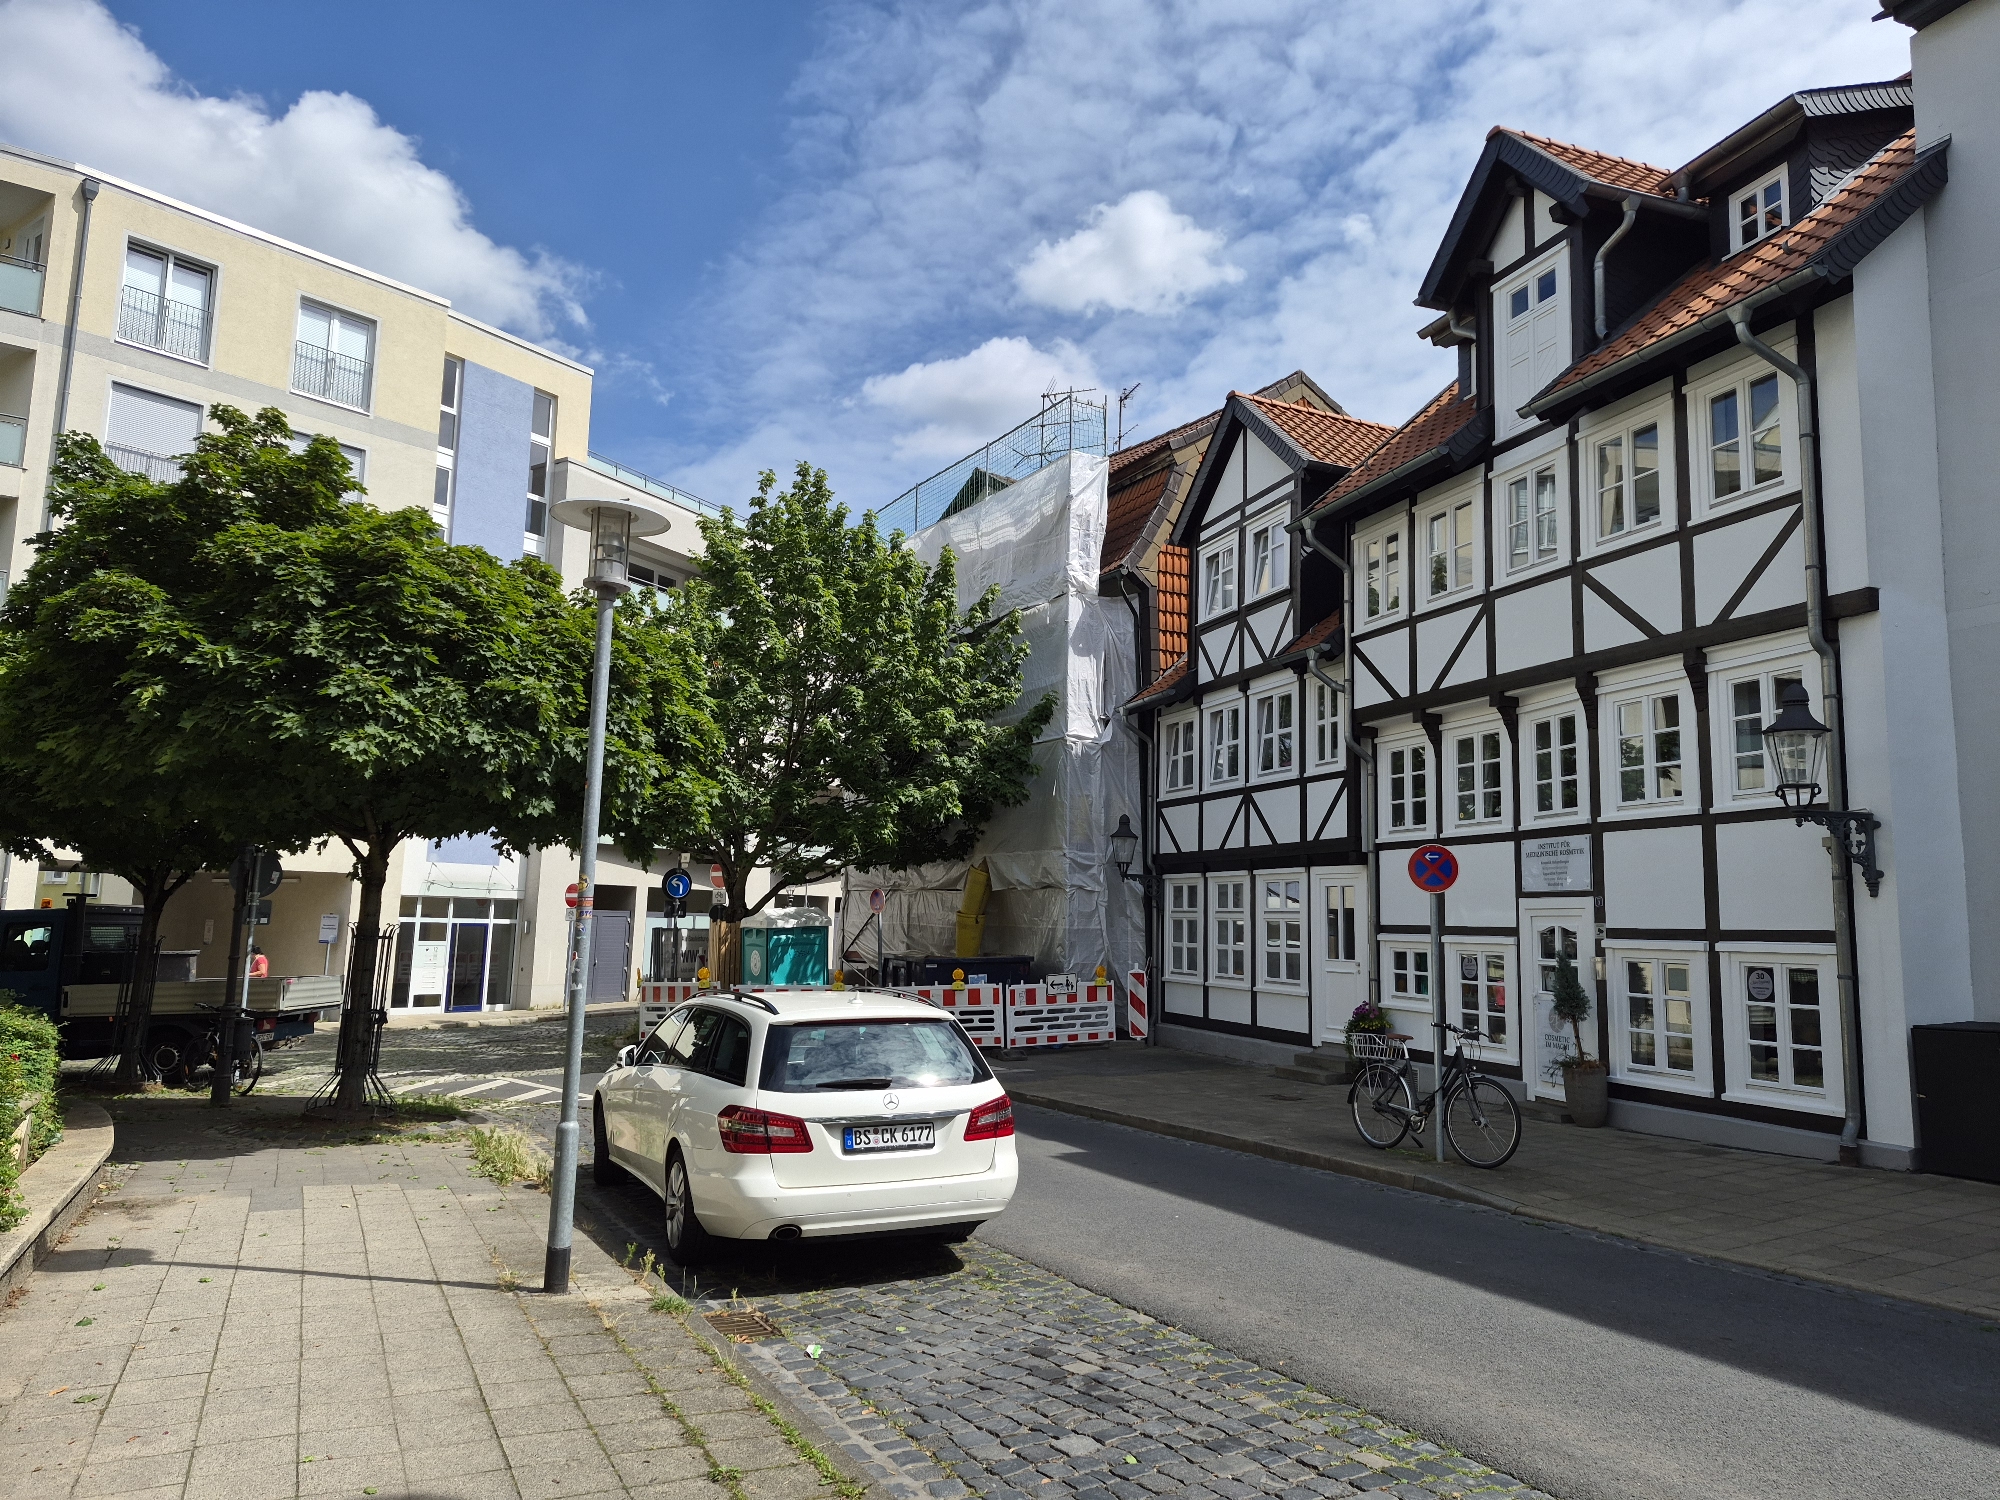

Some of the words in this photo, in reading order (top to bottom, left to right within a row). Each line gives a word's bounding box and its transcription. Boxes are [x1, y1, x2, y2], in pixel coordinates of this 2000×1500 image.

[1526, 849, 1558, 858] MEDIZINISCHE
[1560, 848, 1584, 856] KOSMETIK
[1544, 1034, 1570, 1044] COSMETIC
[854, 1129, 871, 1146] BS
[881, 1127, 898, 1144] CK
[901, 1126, 932, 1143] 6177
